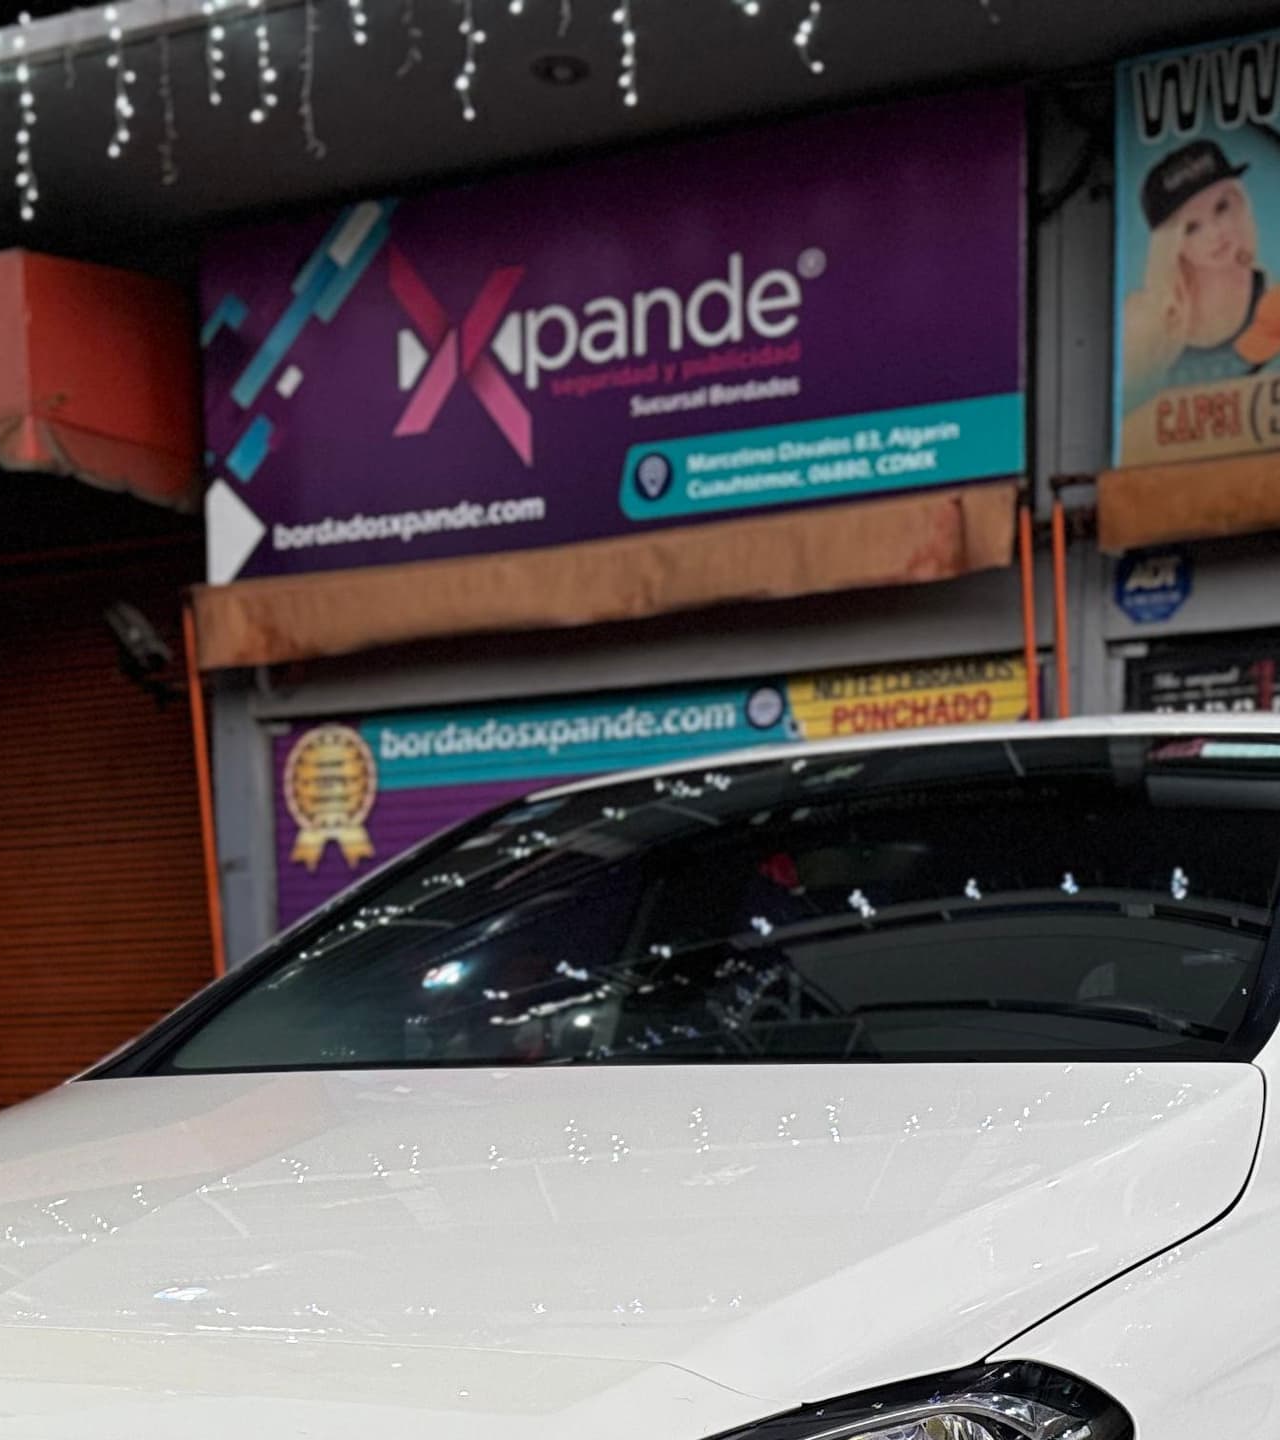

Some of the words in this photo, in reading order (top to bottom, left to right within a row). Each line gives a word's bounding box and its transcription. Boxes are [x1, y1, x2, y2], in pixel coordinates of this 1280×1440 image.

[273, 495, 546, 550] bordadosxpande.com
[380, 703, 737, 761] bordadosxpande.com
[831, 690, 993, 734] PONCHADO
